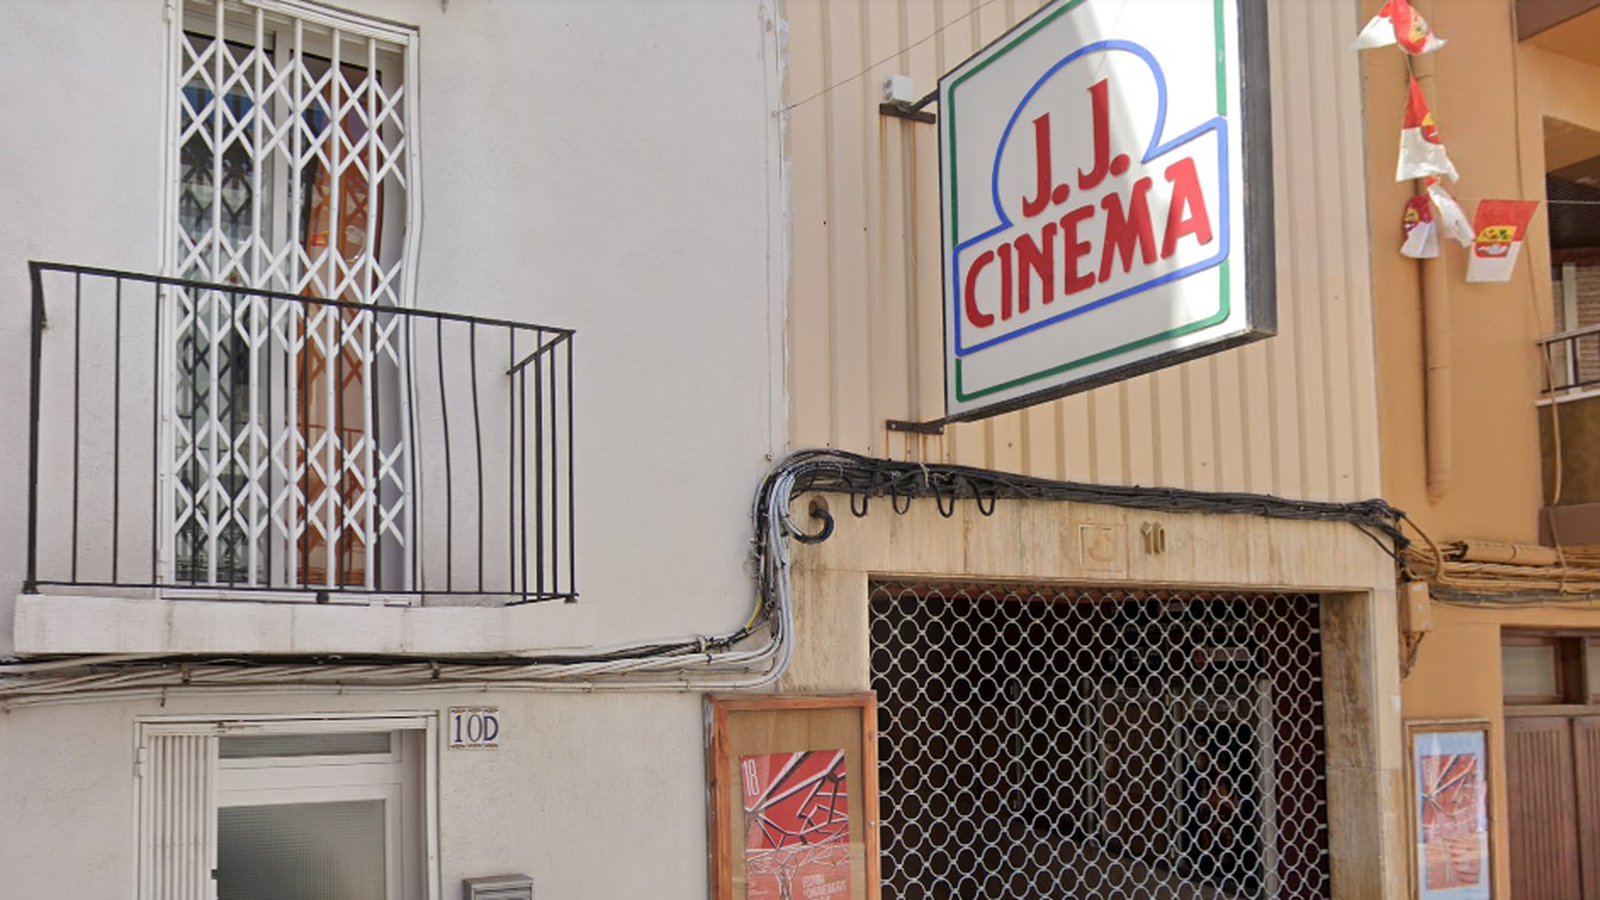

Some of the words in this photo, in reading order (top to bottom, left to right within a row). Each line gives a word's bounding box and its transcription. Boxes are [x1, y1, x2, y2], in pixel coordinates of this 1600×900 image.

[964, 156, 1213, 328] CINEMA
[1140, 520, 1165, 555] 10
[454, 714, 499, 743] 10D
[742, 759, 760, 796] 18
